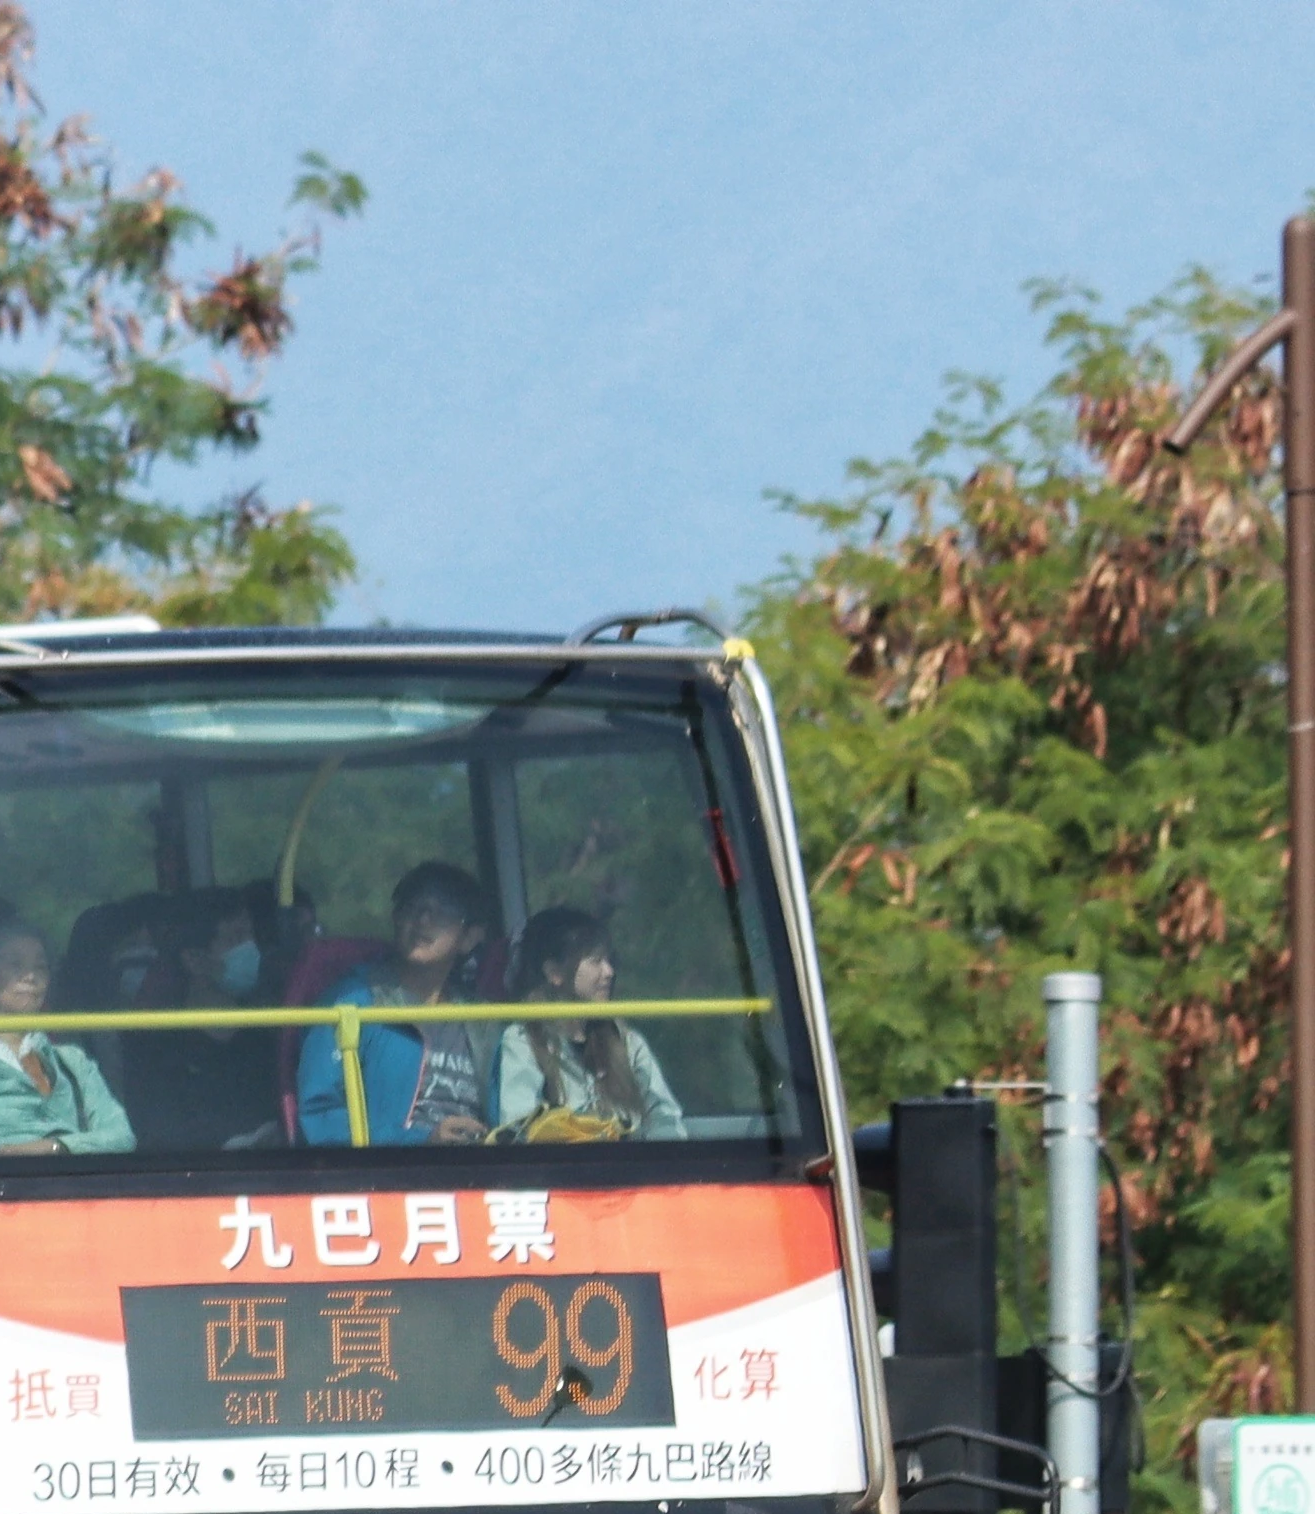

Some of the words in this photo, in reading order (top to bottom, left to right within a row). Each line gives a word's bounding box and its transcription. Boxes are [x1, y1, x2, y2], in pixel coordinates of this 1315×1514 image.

[219, 1190, 555, 1269] 九巴月票
[203, 1288, 401, 1383] 西貢
[492, 1280, 634, 1418] 99
[9, 1368, 101, 1422] 抵買
[225, 1390, 280, 1425] SAI
[304, 1388, 384, 1424] KUNG
[693, 1347, 783, 1401] 化算
